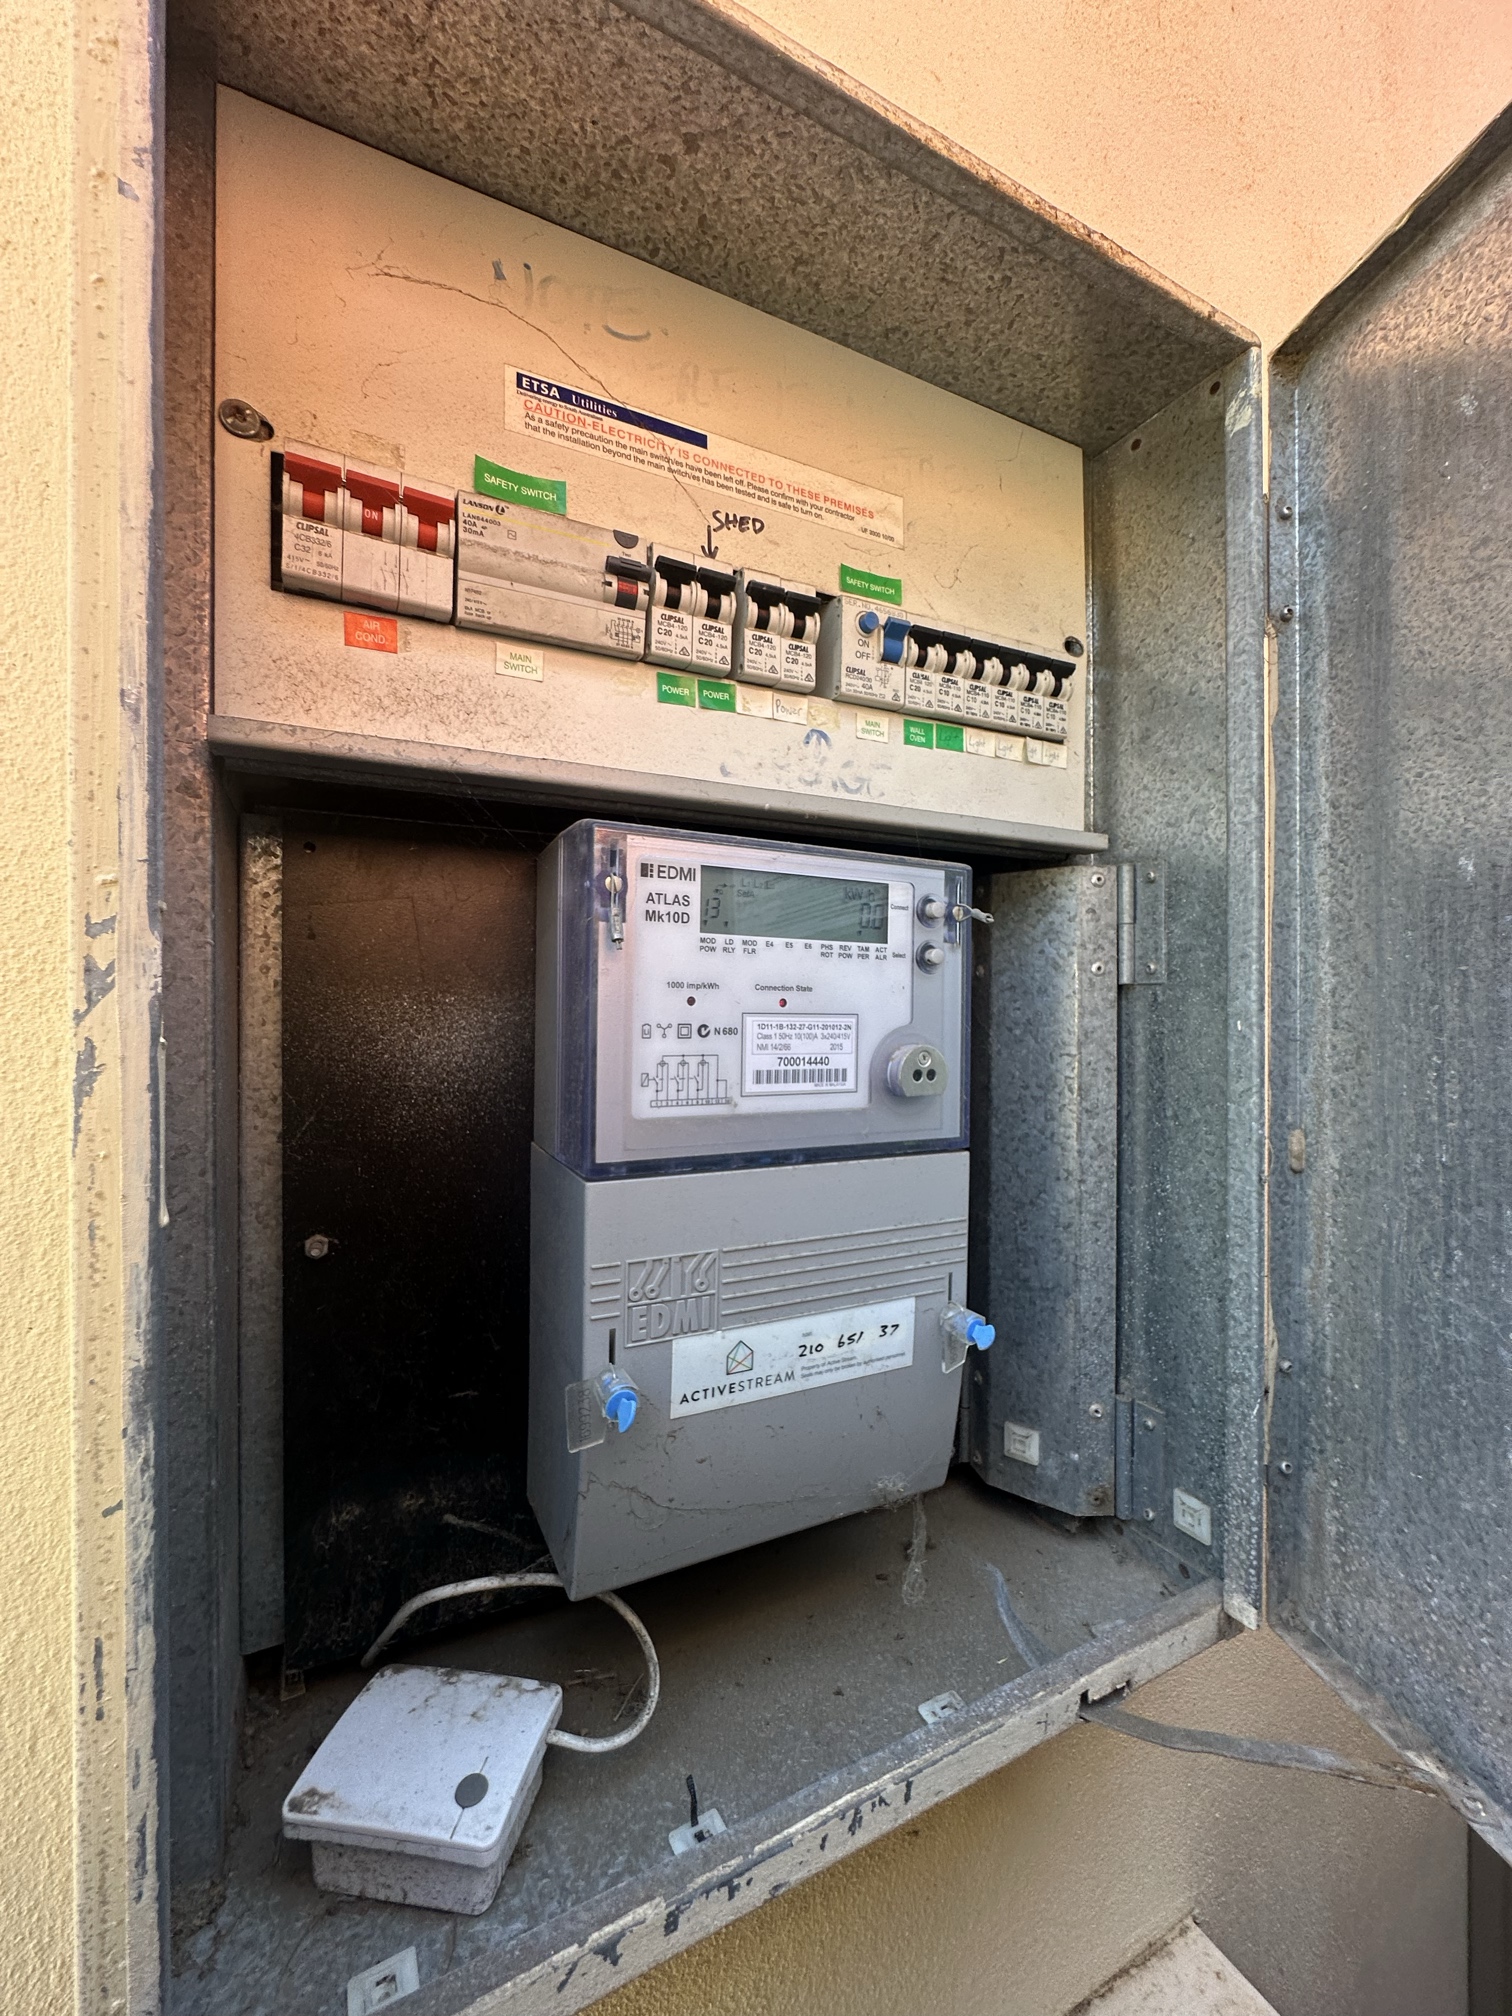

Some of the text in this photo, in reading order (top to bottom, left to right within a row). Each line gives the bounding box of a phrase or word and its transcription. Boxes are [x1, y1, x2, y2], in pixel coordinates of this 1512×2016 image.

[522, 376, 618, 418] ETSA Utilities
[523, 399, 875, 520] CAUTION-ELECTRICITY IS CONNECTED TO THESE PREMISES
[524, 412, 535, 422] As
[544, 418, 570, 434] safety
[571, 426, 614, 445] precaution
[615, 440, 628, 450] the
[629, 444, 648, 457] main
[650, 450, 684, 467] switch/es
[685, 459, 702, 473] have
[704, 468, 722, 480] been
[723, 472, 733, 484] left
[746, 481, 769, 495] Please
[770, 488, 794, 504] confirm
[796, 496, 808, 507] with
[810, 502, 824, 514] your
[824, 505, 855, 521] contractor
[524, 422, 540, 434] that
[542, 426, 556, 438] the
[557, 430, 600, 452] installation
[602, 444, 632, 461] beyond
[633, 453, 646, 464] the
[647, 458, 666, 471] main
[666, 464, 700, 482] switch/es
[702, 477, 714, 488] has
[716, 480, 734, 492] been
[734, 485, 756, 500] tested
[757, 492, 770, 503] and
[771, 496, 776, 505] is
[778, 500, 792, 510] safe
[792, 504, 799, 512] to
[800, 508, 813, 517] turn
[484, 473, 557, 502] SAFETY SWITCH
[462, 498, 494, 512] LANSON
[364, 509, 378, 521] ON
[462, 519, 478, 528] 40A
[712, 509, 765, 535] SHED
[296, 522, 330, 537] CLIPSAL
[462, 526, 484, 537] 30mA
[294, 543, 311, 554] C32
[846, 576, 895, 596] SAFETY SWITCH
[661, 613, 684, 624] CLIPSAL
[363, 619, 380, 630] AIR
[702, 624, 724, 634] CLIPSAL
[752, 634, 773, 644] CLIPSAL
[858, 638, 870, 648] ON
[788, 644, 809, 653] CLIPSAL
[510, 652, 532, 664] MAIN
[855, 650, 871, 660] OFF
[504, 660, 538, 675] SWITCH
[846, 666, 866, 676] CLIPSAL
[942, 676, 958, 686] CLIPSAL
[662, 684, 690, 696] POWER
[970, 684, 986, 692] CLIPSAL
[997, 689, 1013, 698] CLIPSAL
[702, 690, 730, 701] POWER
[1024, 696, 1039, 704] CLIPSAL
[1049, 702, 1064, 710] CLIPSAL
[865, 720, 881, 729] MAIN
[860, 728, 884, 738] SWITCH
[909, 726, 925, 736] WALL
[909, 734, 926, 744] OVEN
[657, 864, 696, 882] EDMI
[646, 892, 690, 907] ATLAS
[645, 910, 690, 924] Mk10D
[722, 946, 736, 954] RLY
[724, 938, 734, 946] LD
[840, 944, 852, 952] REV
[666, 981, 720, 991] 1000 imp/kWh
[754, 984, 813, 992] Connection State
[714, 1027, 738, 1036] N 680
[756, 1032, 772, 1040] Class
[794, 1032, 818, 1041] 10(100)A
[830, 1043, 844, 1051] 2015
[777, 1056, 830, 1067] 700014440
[631, 1296, 711, 1343] EDMI
[798, 1324, 900, 1358] 210 651 37
[800, 1362, 820, 1372] Property
[827, 1358, 841, 1366] Active
[680, 1370, 796, 1405] ACTIVESTREAM
